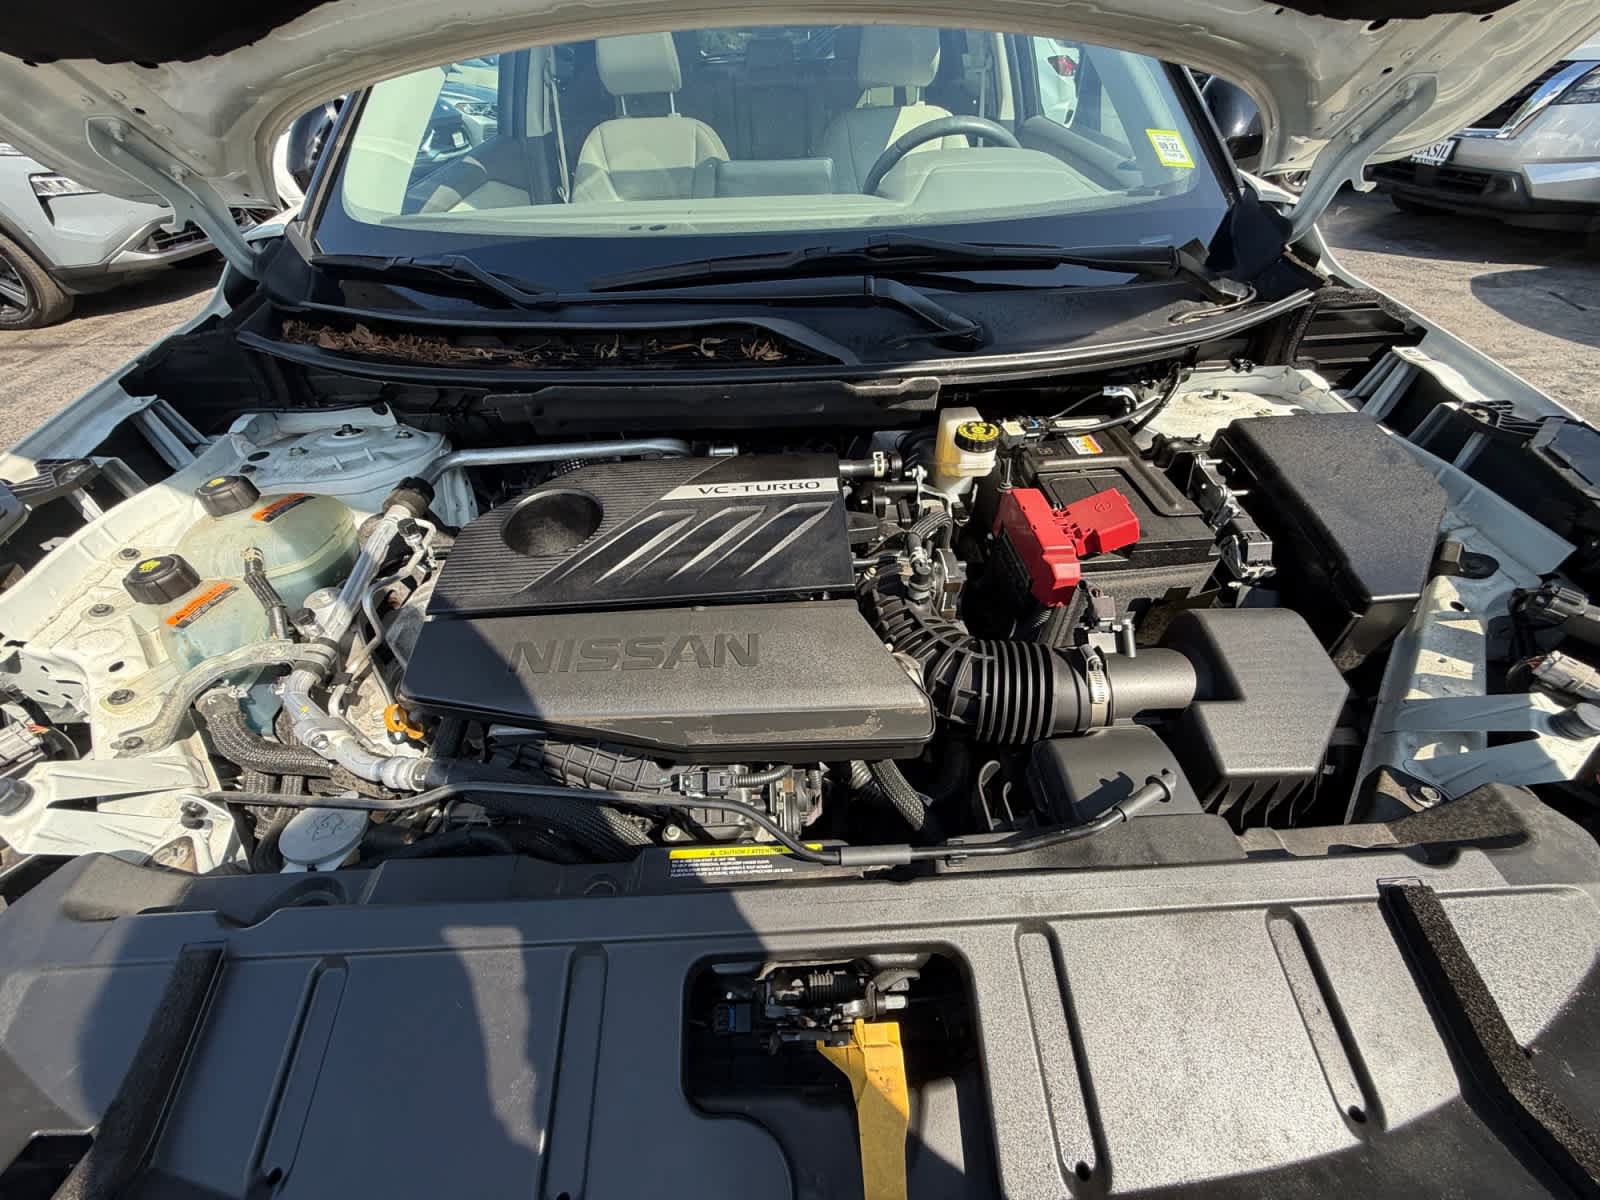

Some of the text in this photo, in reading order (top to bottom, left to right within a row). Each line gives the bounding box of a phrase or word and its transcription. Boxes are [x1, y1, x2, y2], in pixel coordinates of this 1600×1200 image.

[698, 481, 820, 494] VC-TURBO
[508, 633, 760, 673] NISSAN
[751, 847, 783, 855] ATTENTION
